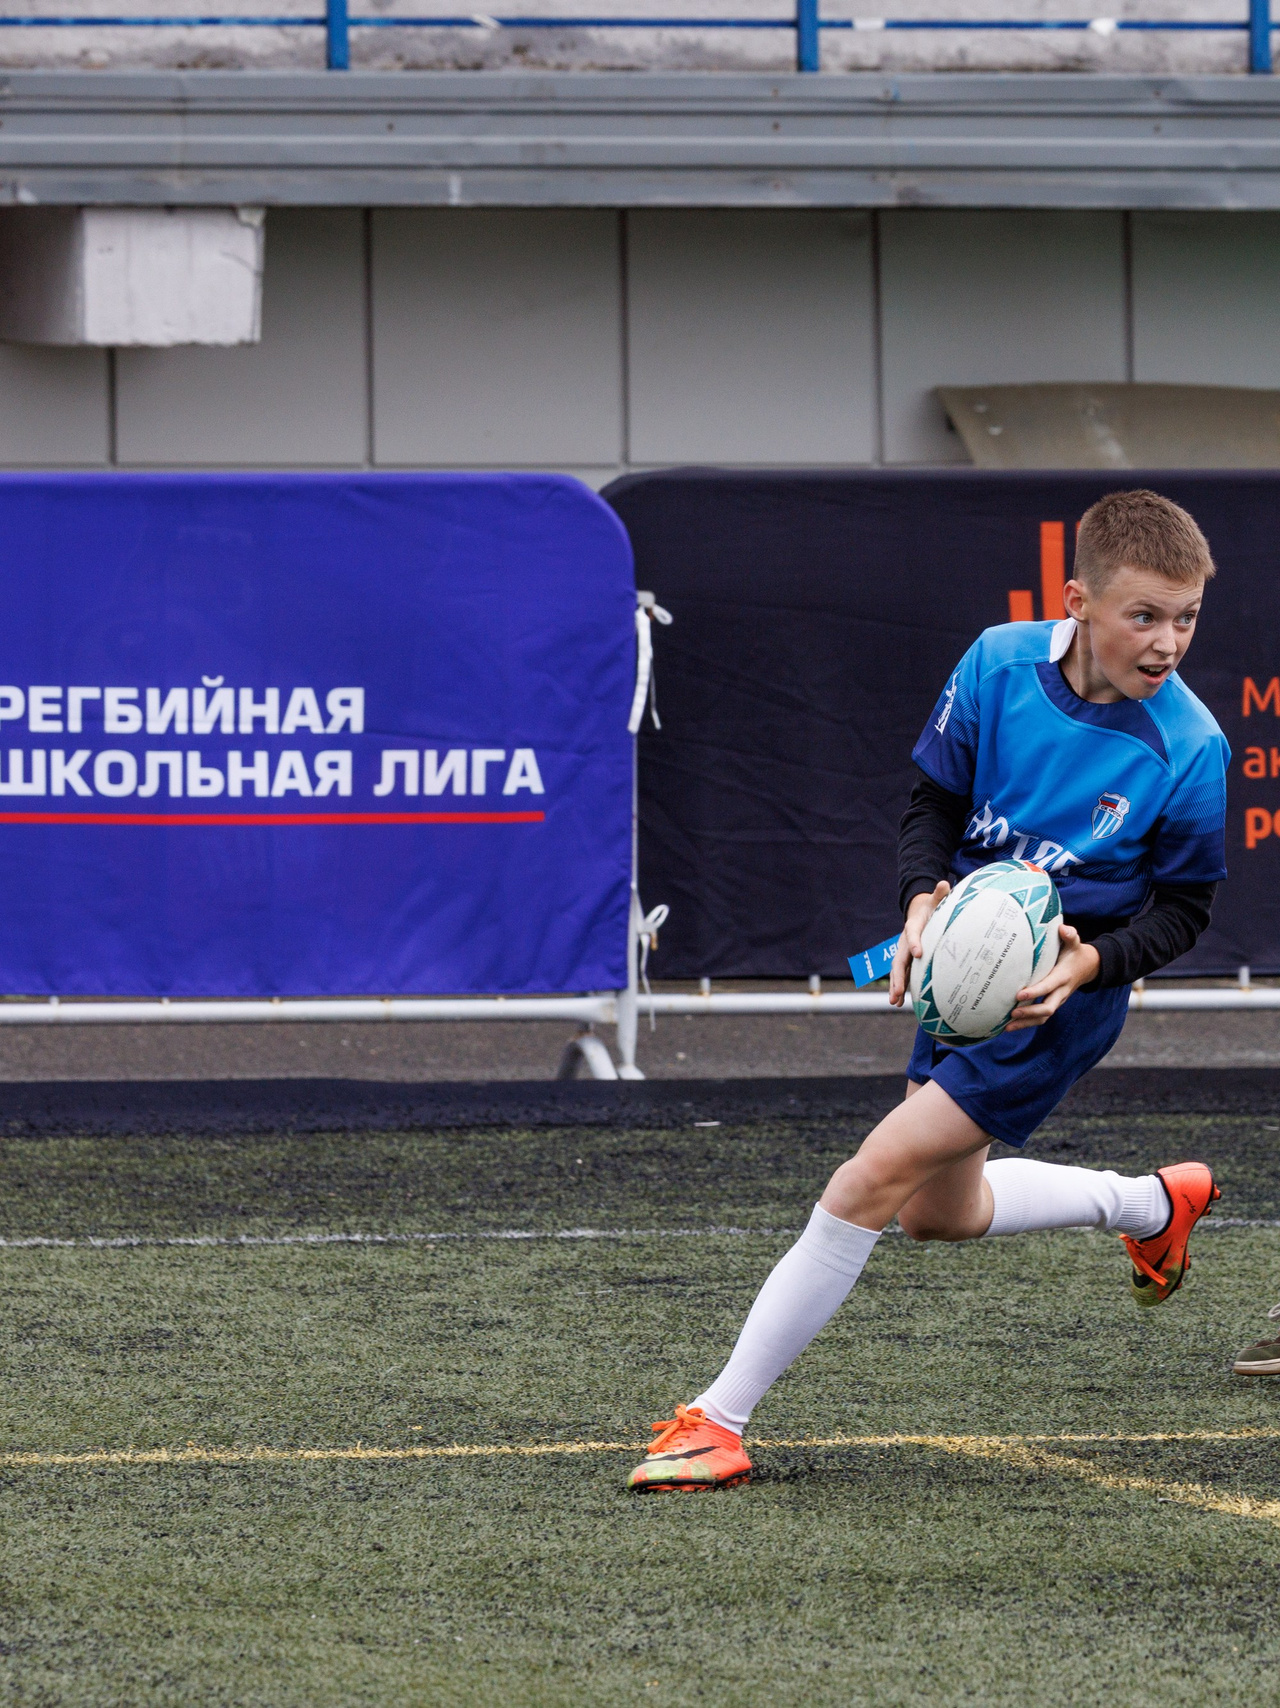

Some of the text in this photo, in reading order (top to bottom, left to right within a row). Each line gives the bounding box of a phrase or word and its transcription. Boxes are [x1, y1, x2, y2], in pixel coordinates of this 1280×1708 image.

[0, 674, 365, 734] РЕГБИЙНАЯ
[0, 748, 545, 798] ШКОЛЬНАЯ ЛИГА
[1001, 932, 1017, 958] ВТОРАЯ
[988, 958, 1003, 981] ЖИЗНЬ
[970, 980, 991, 1011] ПЛАСТИКА
